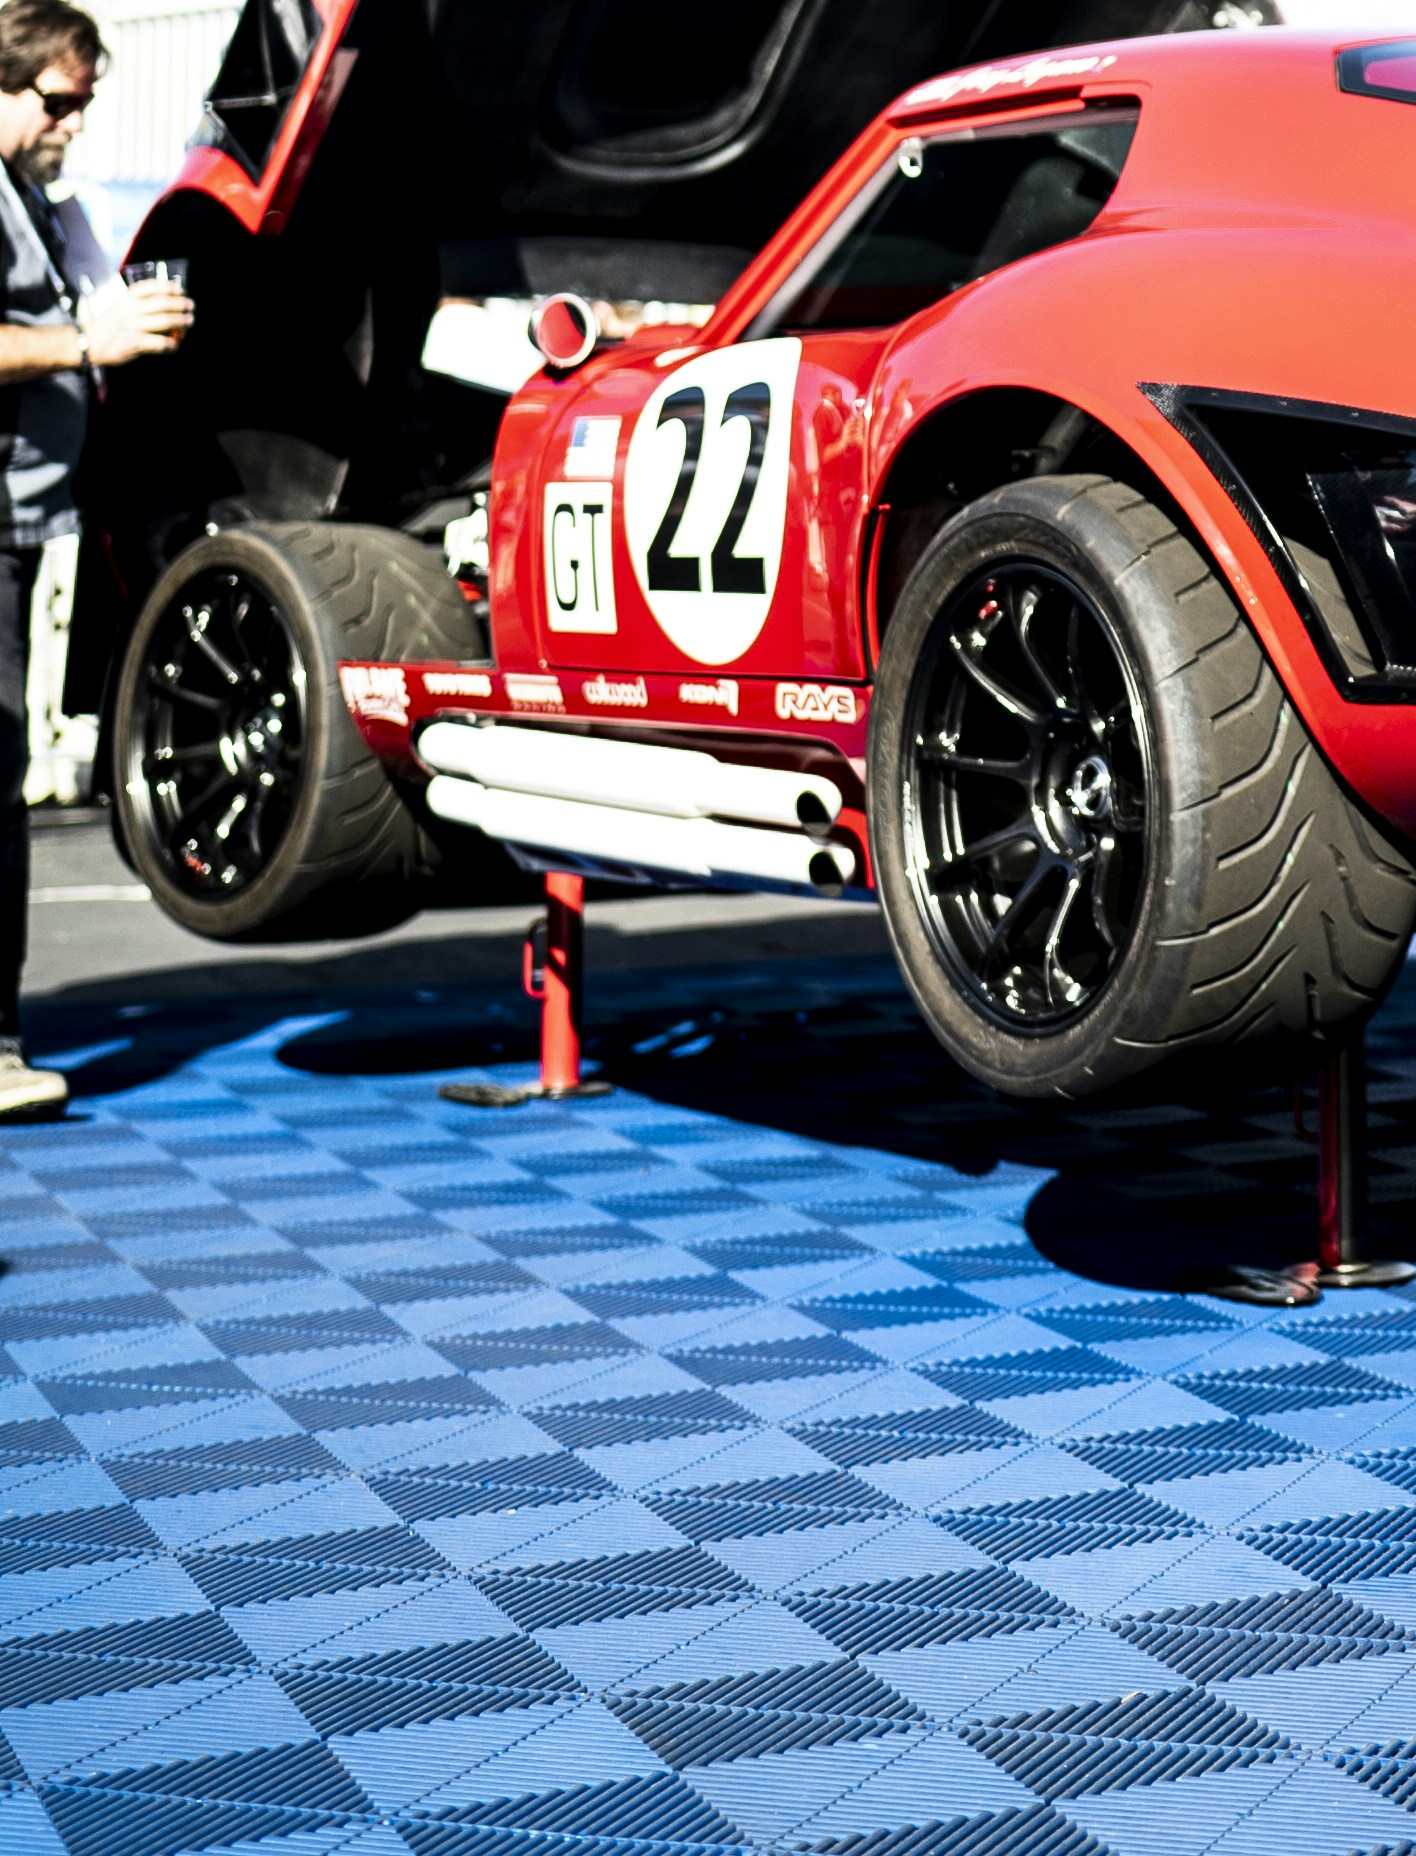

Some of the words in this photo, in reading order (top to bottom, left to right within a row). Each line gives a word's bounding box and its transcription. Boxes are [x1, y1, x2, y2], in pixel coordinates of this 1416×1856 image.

[647, 382, 772, 595] 22
[552, 503, 604, 612] GT
[775, 683, 857, 724] RAYS
